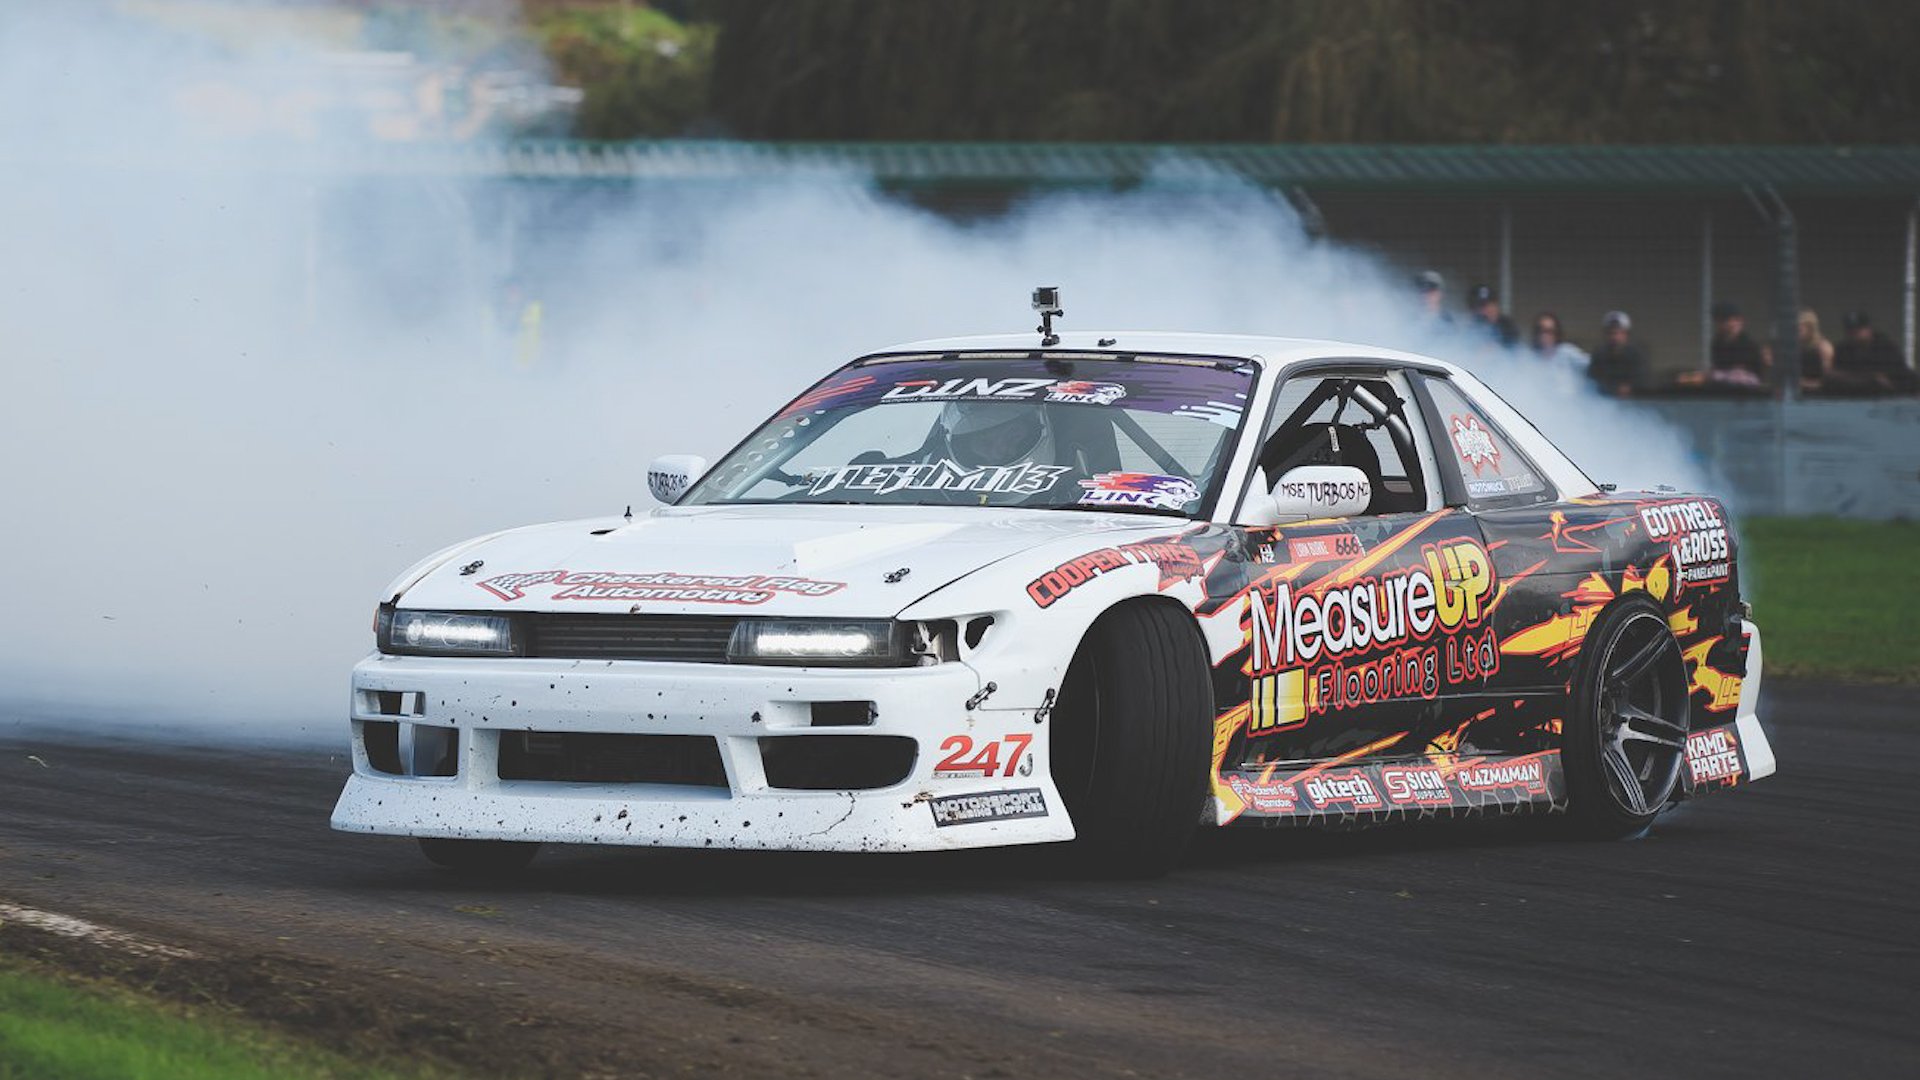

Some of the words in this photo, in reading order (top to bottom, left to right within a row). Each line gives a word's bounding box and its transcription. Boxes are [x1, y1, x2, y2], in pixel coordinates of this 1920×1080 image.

[1282, 482, 1305, 498] MSE
[1306, 482, 1355, 506] TURBOS
[1357, 482, 1369, 500] NZ
[1641, 501, 1722, 537] COTTRELL
[1261, 553, 1275, 564] NZ
[561, 572, 748, 588] Checkered
[753, 577, 839, 594] Flag
[1026, 547, 1133, 609] COOPER
[1118, 543, 1201, 568] TYRES
[563, 584, 765, 603] Automotive
[1319, 649, 1435, 708] Flooring
[1450, 630, 1494, 677] Ltd
[1686, 732, 1728, 759] KAMO
[1459, 763, 1541, 787] PLAZMAMAN
[1689, 751, 1741, 781] PARTS
[1306, 774, 1373, 804] gktech
[1405, 769, 1446, 791] SIGN
[931, 791, 1041, 811] MOTORSPORT
[1414, 789, 1450, 801] SUPPLIES
